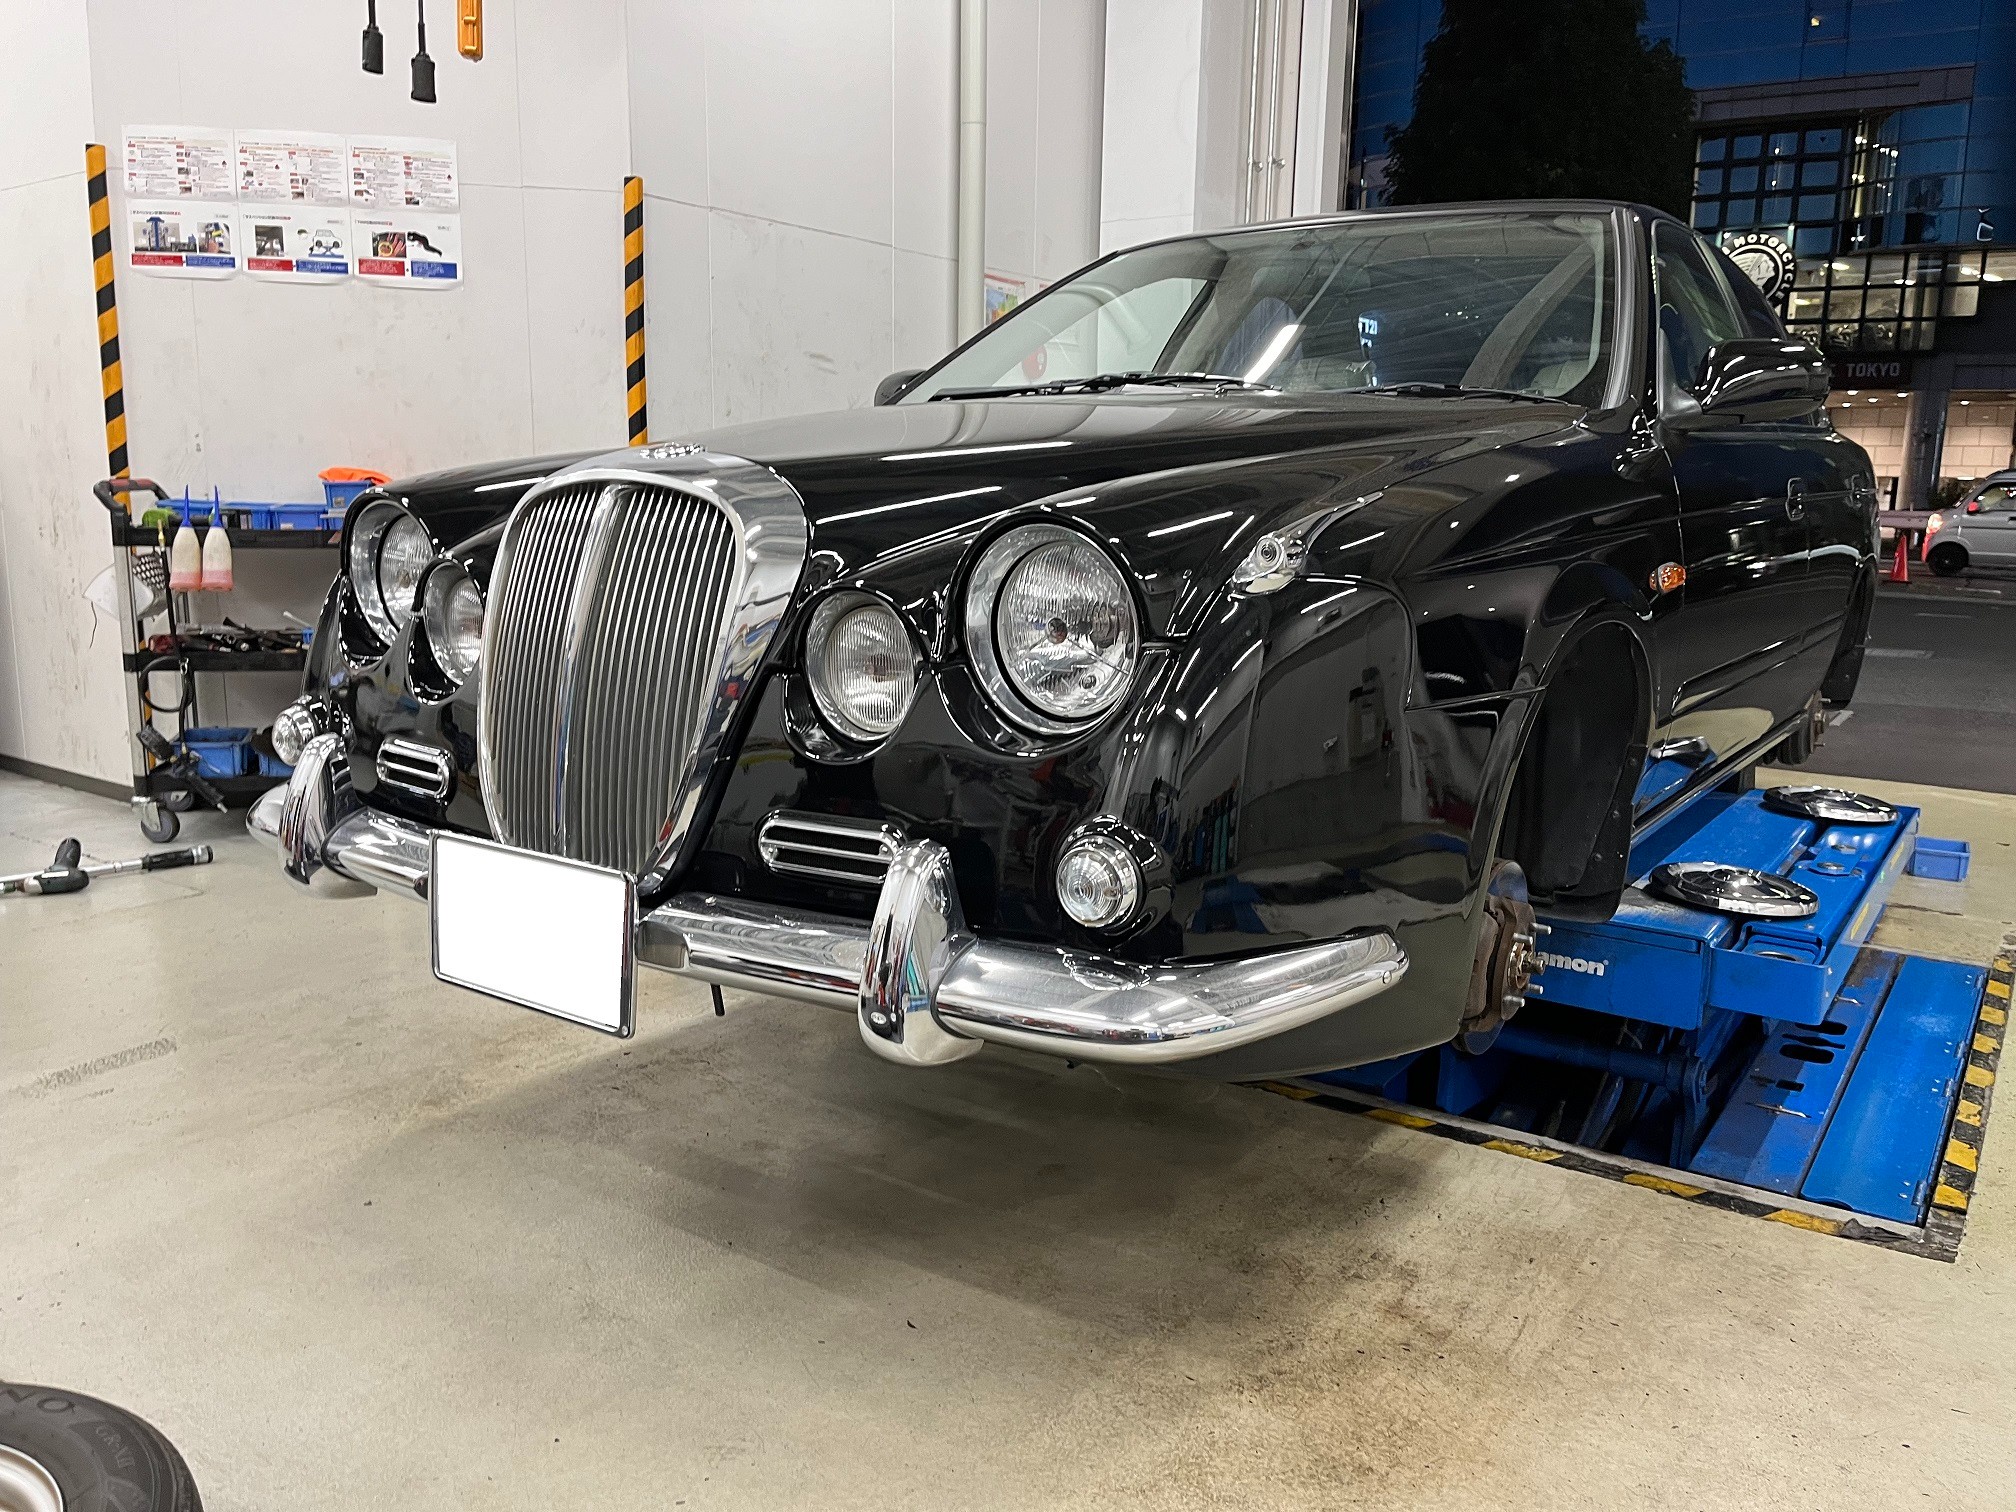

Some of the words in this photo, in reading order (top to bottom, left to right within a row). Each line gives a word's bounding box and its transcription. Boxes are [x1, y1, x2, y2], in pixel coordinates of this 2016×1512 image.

[1733, 233, 1795, 299] MOTORCYCLE
[1846, 362, 1901, 378] TOKYO
[1536, 951, 1605, 976] amon
